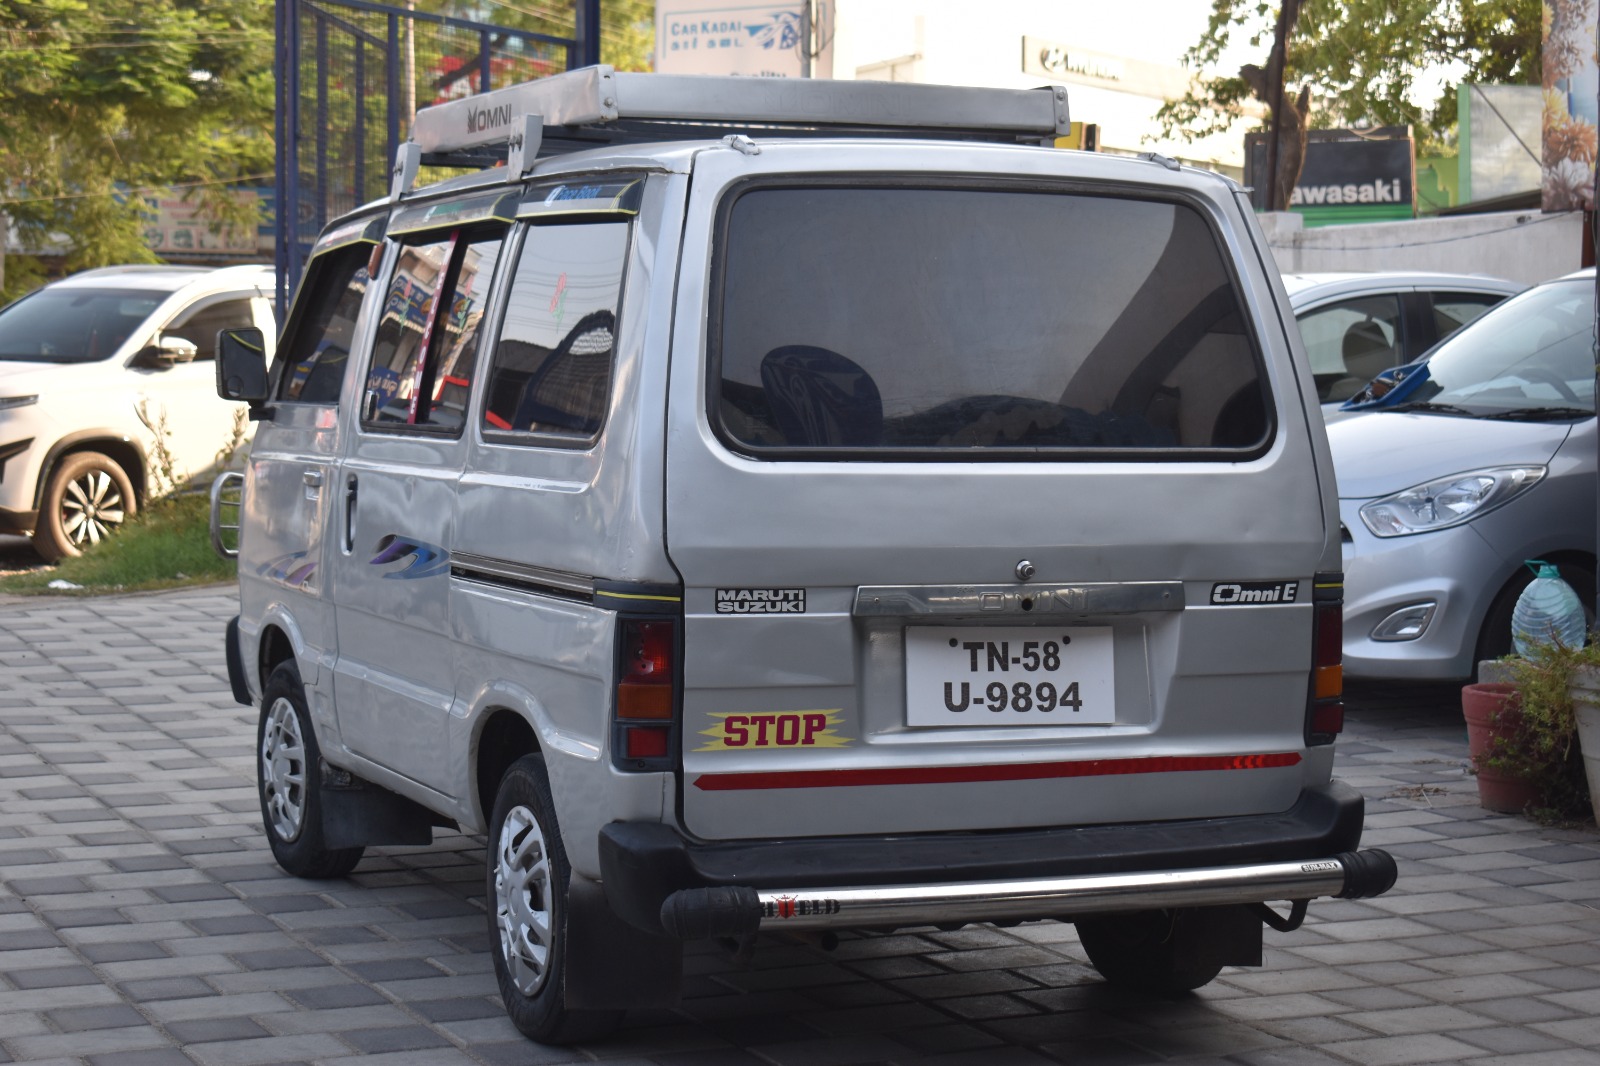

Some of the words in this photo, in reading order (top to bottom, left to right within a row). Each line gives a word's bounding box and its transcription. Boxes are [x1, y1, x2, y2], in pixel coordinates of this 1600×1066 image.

[477, 103, 512, 132] OMNI
[1289, 178, 1401, 205] awasaki
[717, 589, 804, 601] MARUTI
[717, 601, 804, 613] SUZUKI
[1212, 584, 1281, 603] Omni
[1282, 583, 1297, 601] E
[963, 640, 1061, 672] TN-58
[943, 681, 1083, 713] U-9894
[723, 713, 827, 747] STOP
